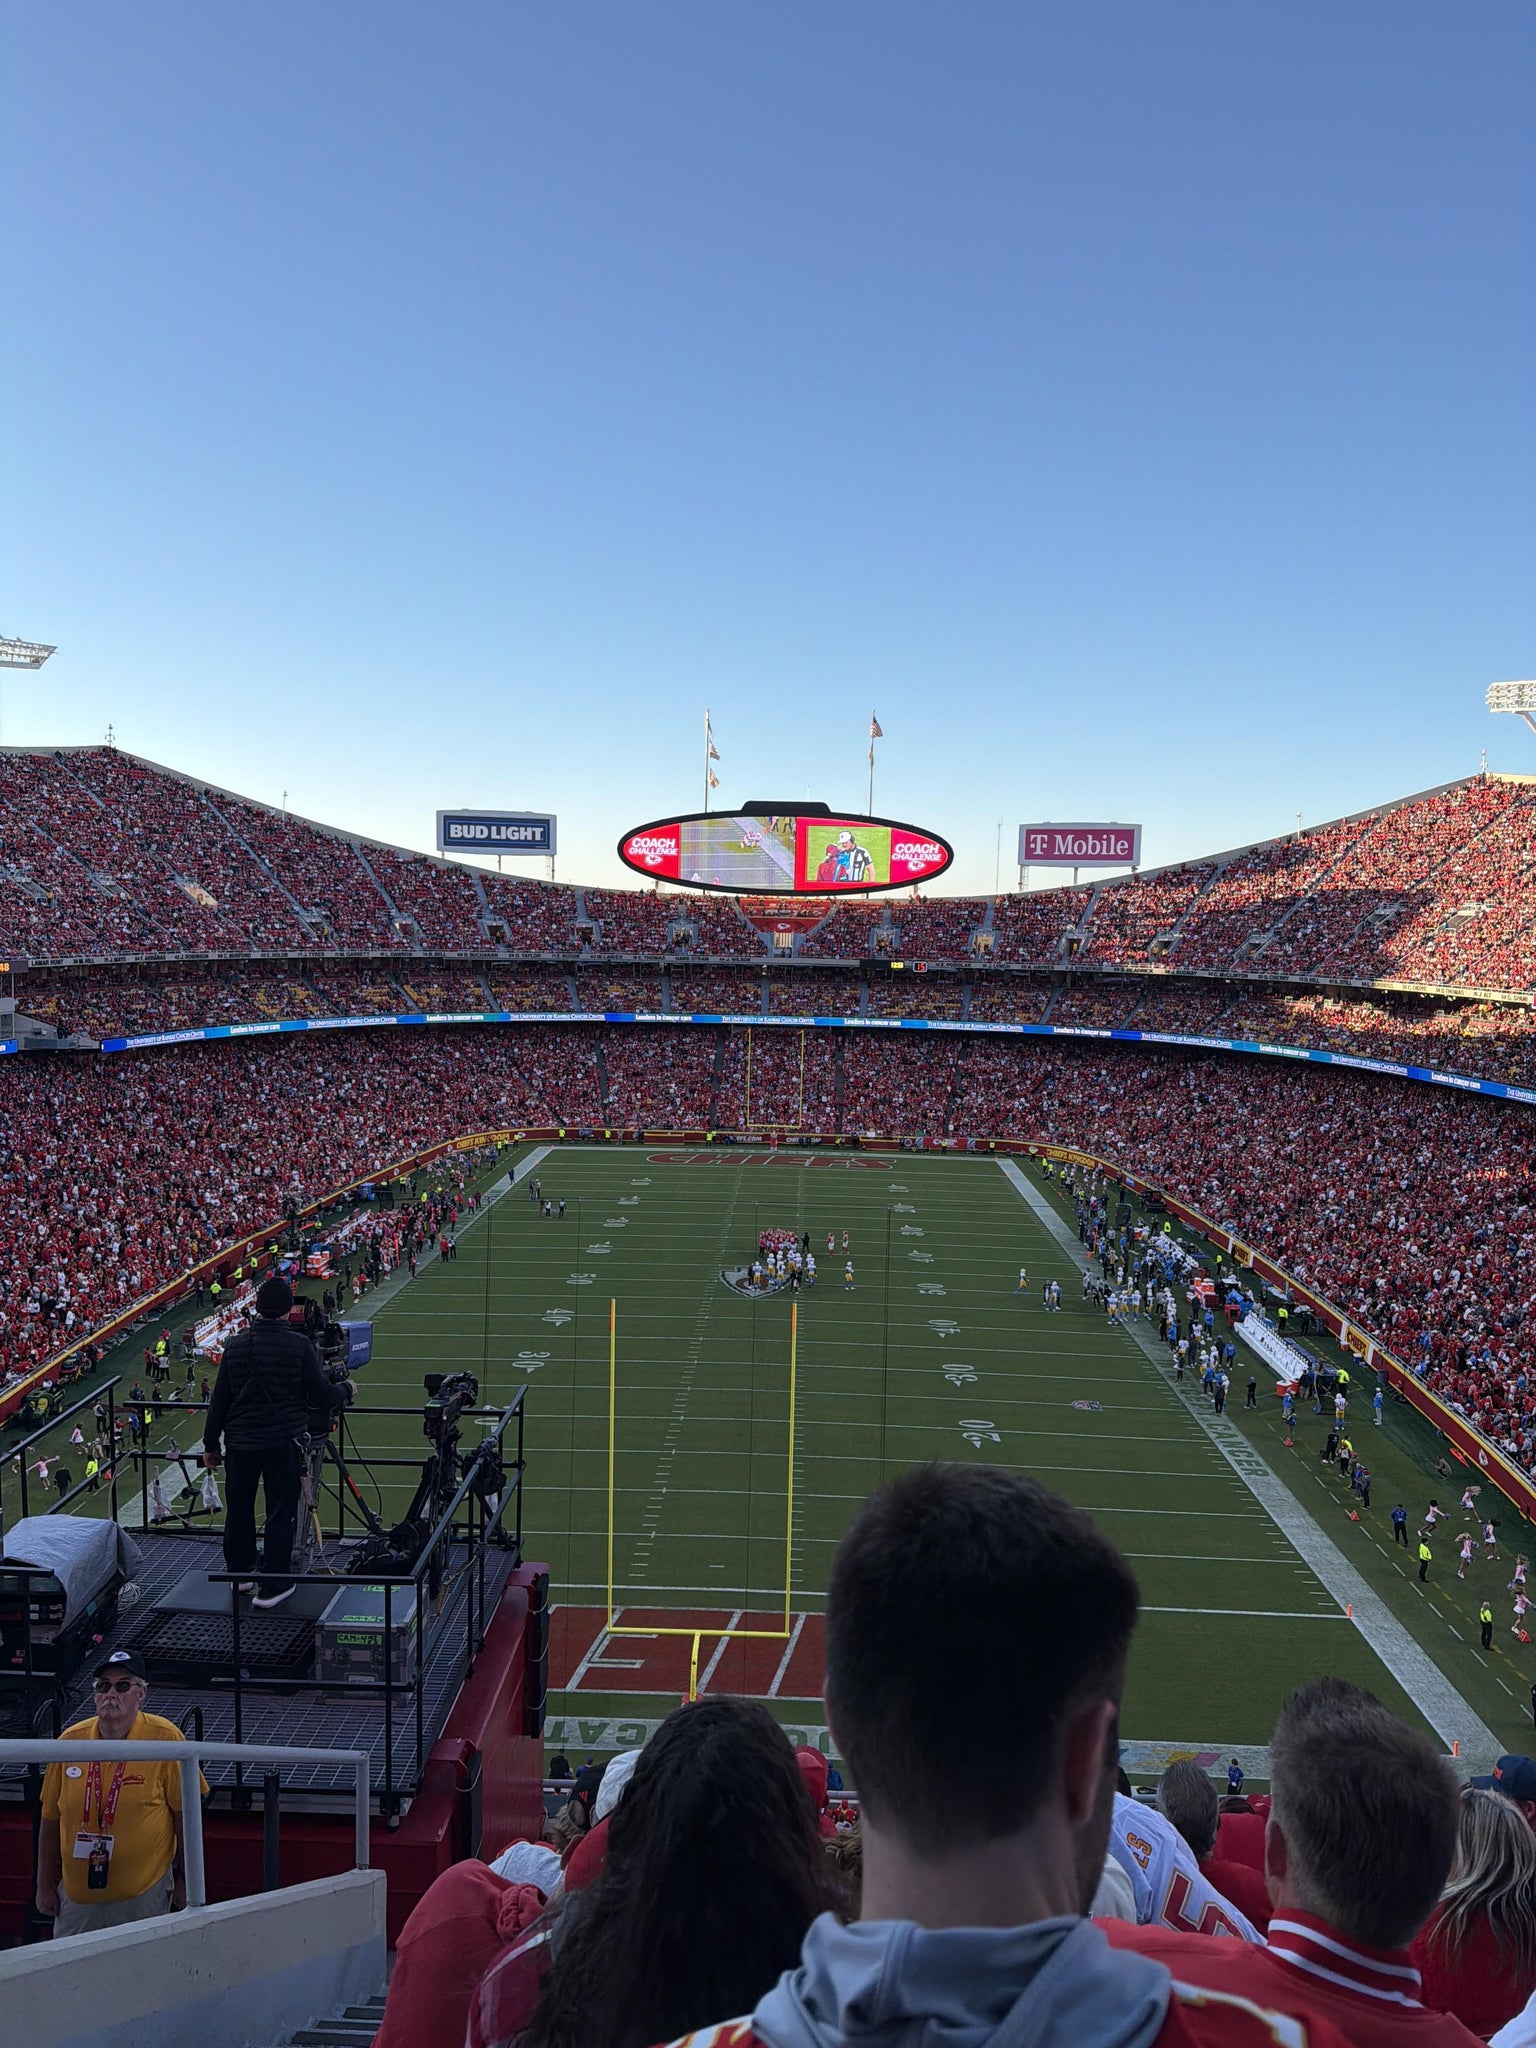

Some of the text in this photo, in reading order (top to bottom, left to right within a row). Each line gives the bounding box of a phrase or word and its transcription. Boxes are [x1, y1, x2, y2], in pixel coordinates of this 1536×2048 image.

[450, 824, 544, 841] BUD LIGHT
[631, 837, 675, 848] COACH
[895, 843, 939, 854] COACH
[1030, 834, 1129, 856] T Mobile
[629, 847, 678, 856] CHALLENGE
[892, 852, 942, 861] CHALLENGE
[457, 1133, 510, 1149] CHIEFS KINDOM
[646, 1153, 897, 1170] CHIEFS
[917, 1282, 947, 1296] 50
[541, 1308, 576, 1322] 40
[928, 1319, 961, 1334] 40
[512, 1351, 551, 1368] 30
[942, 1363, 978, 1382] 30
[958, 1419, 1002, 1442] 20
[1206, 1423, 1270, 1477] CANCER
[544, 1720, 649, 1746] CAT
